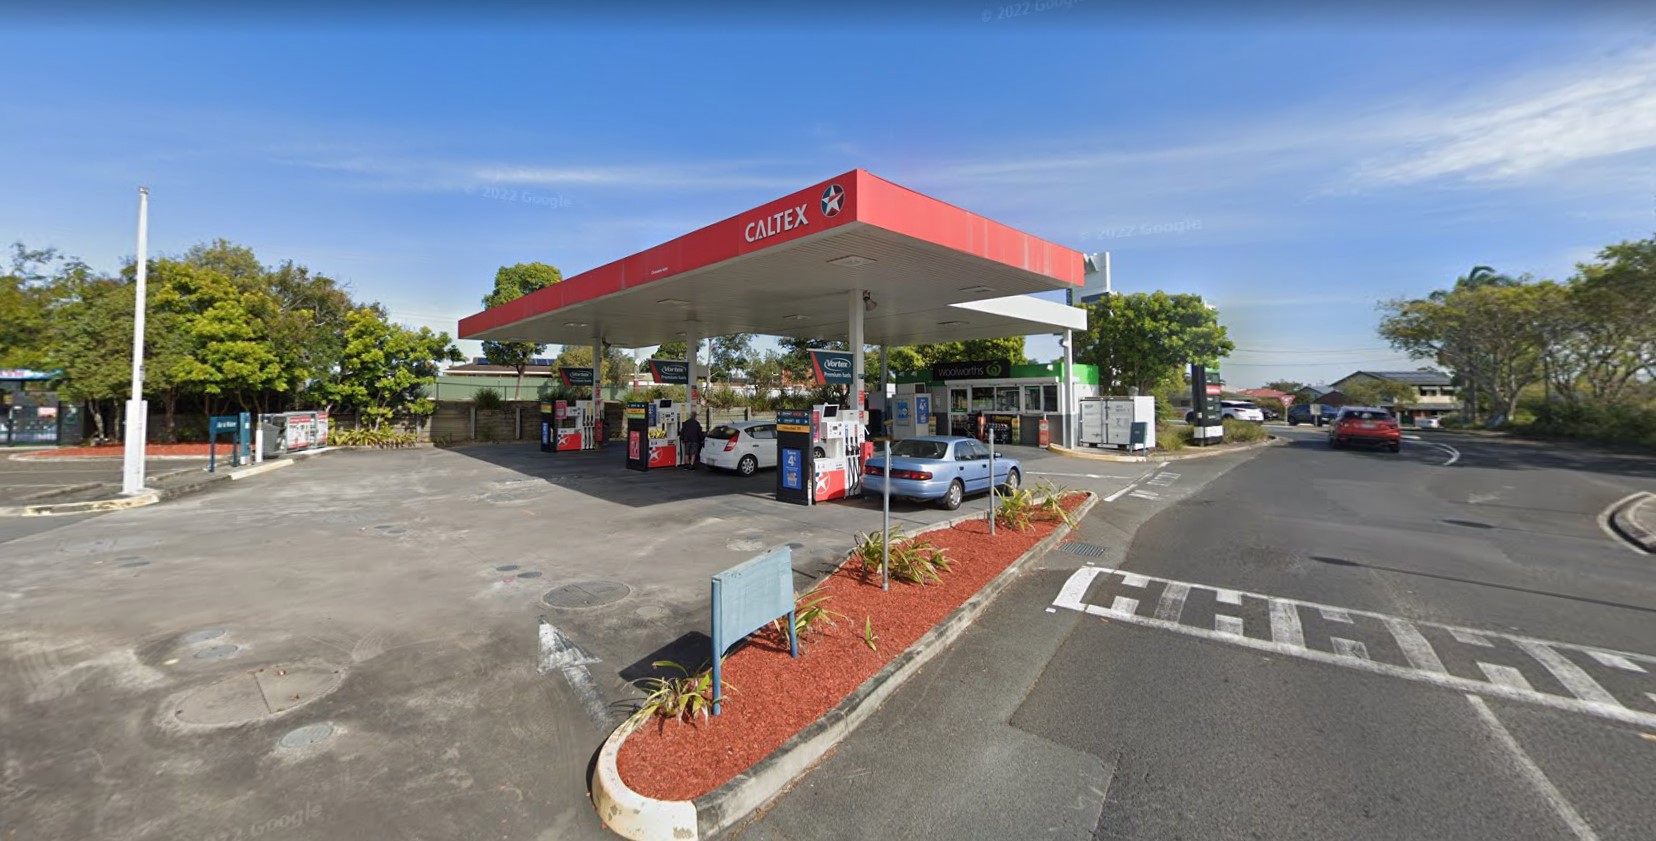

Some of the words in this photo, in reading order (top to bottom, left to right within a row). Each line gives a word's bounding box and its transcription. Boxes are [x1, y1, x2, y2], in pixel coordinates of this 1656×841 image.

[744, 203, 809, 243] CALTEX
[826, 359, 848, 368] Vortex
[664, 365, 684, 373] Vortex
